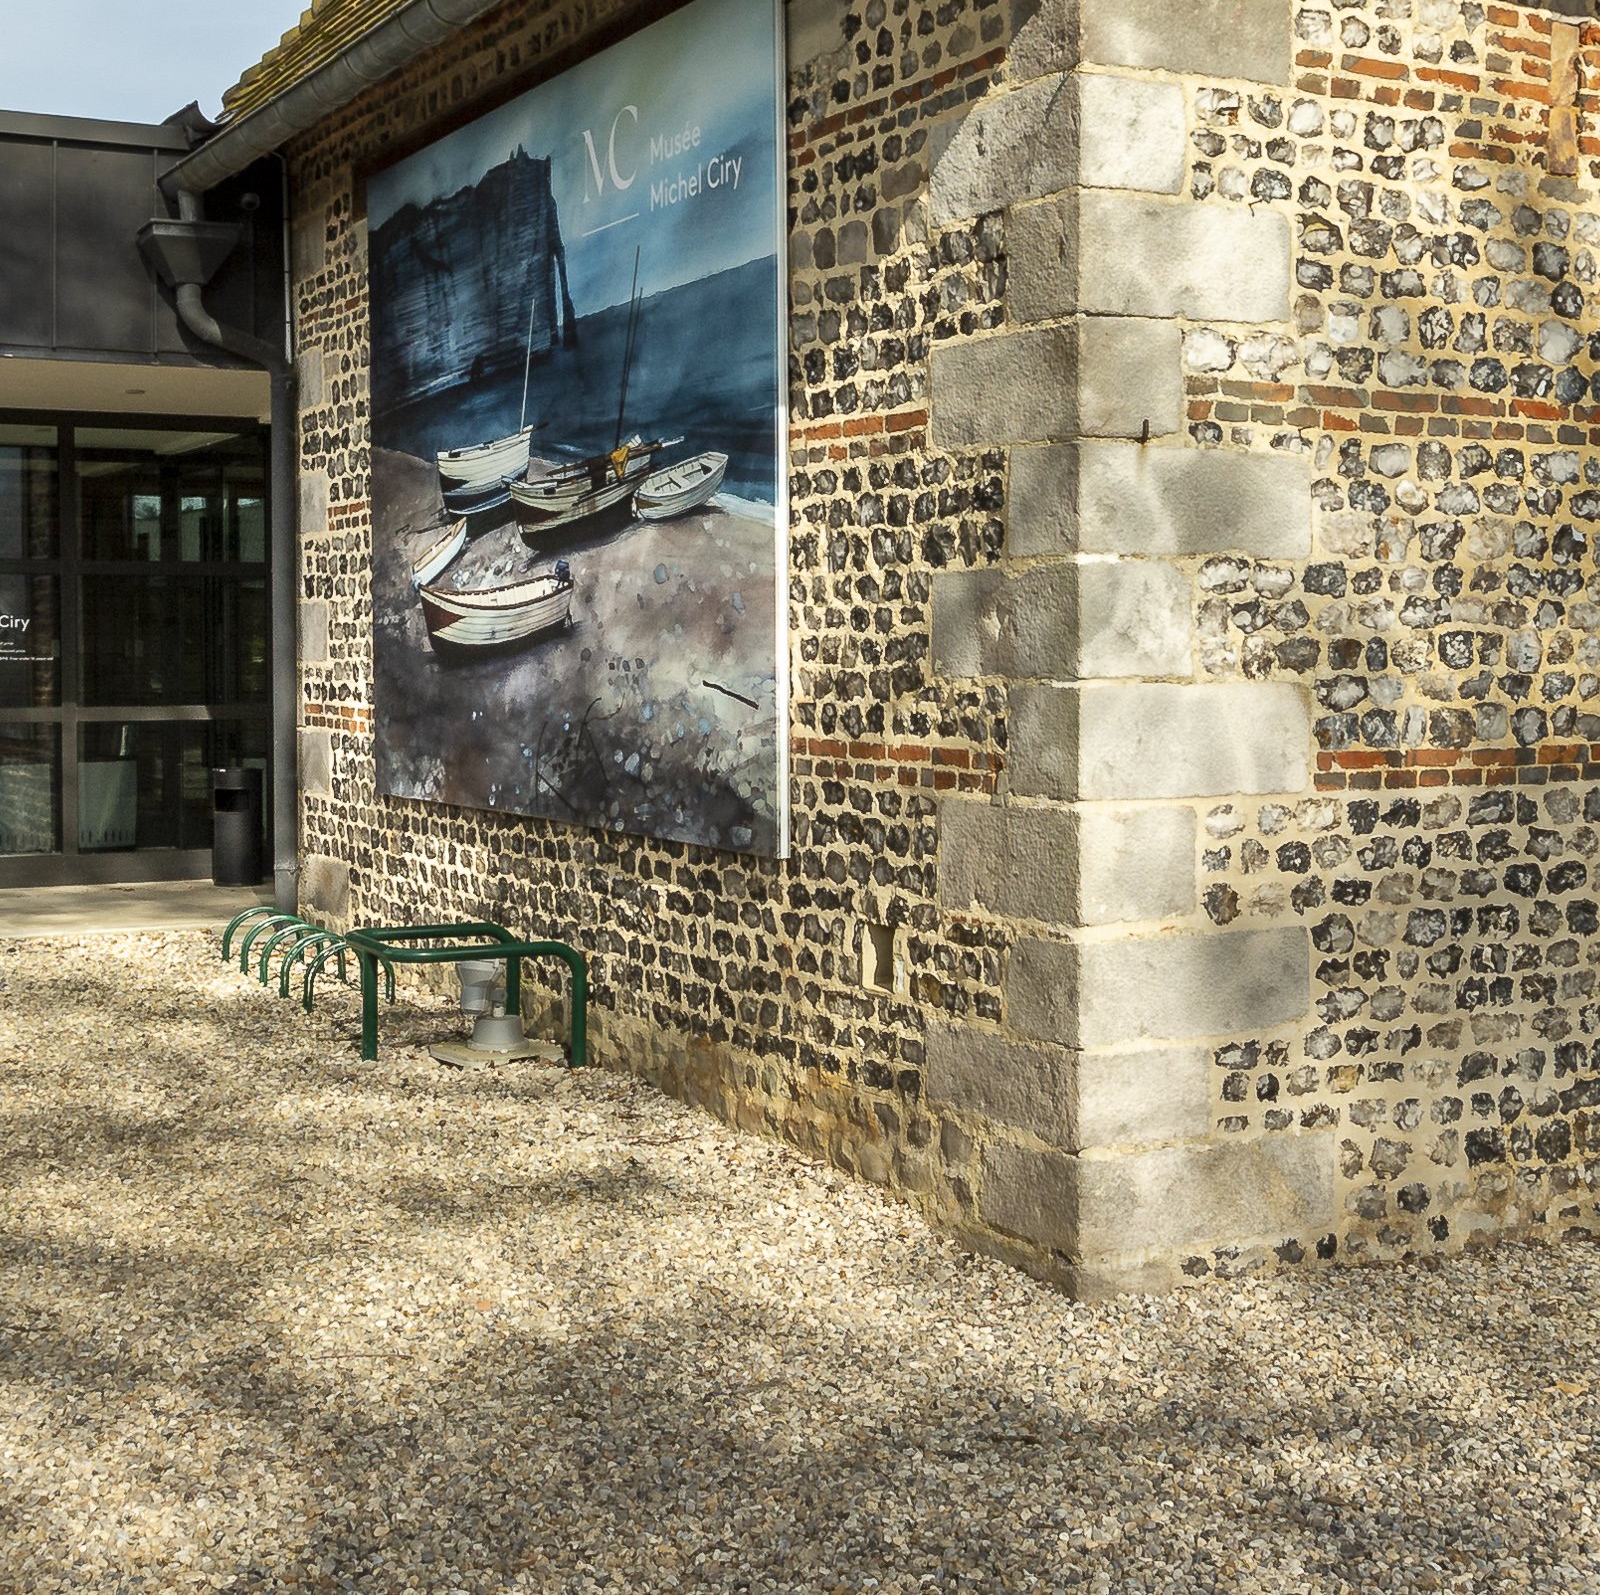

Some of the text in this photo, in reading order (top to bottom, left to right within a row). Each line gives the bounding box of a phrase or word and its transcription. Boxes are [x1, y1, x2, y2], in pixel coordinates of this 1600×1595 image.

[581, 104, 638, 204] MC
[650, 121, 701, 166] Musée
[650, 154, 742, 211] Michel Ciry
